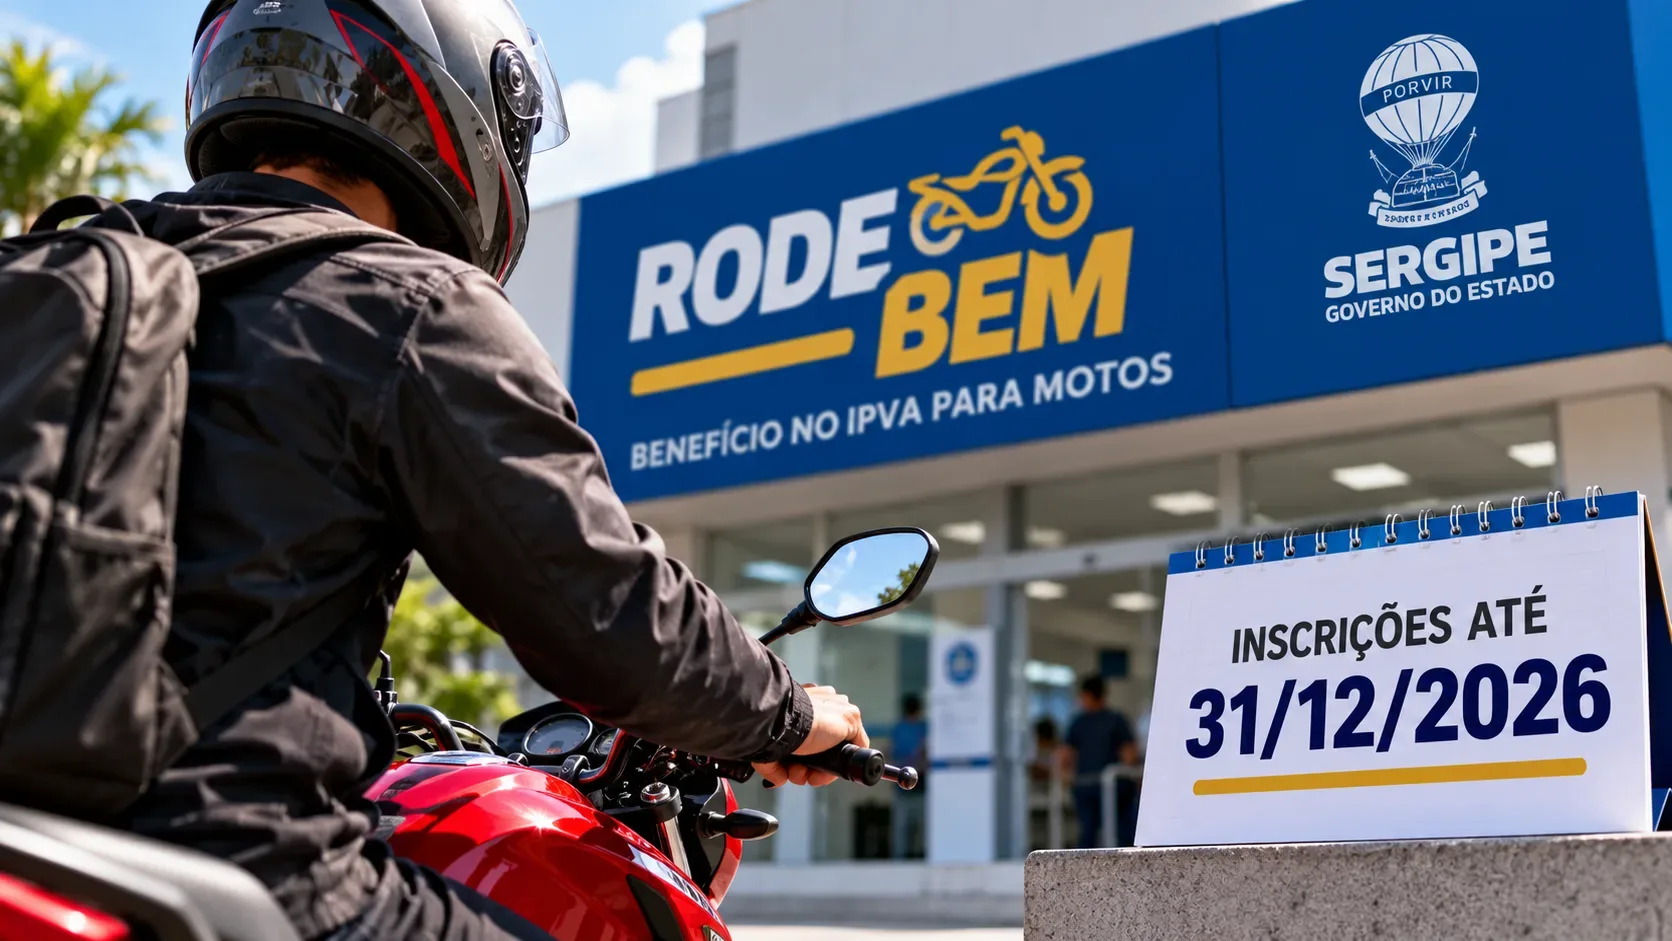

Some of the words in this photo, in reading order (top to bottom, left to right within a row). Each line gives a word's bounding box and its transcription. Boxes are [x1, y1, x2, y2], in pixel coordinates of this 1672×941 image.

[1382, 75, 1453, 103] PORVIR
[629, 188, 898, 342] RODE
[875, 227, 1134, 379] BEM
[1323, 220, 1552, 299] SERGIPE
[1325, 291, 1425, 323] GOVERNO
[1431, 285, 1462, 307] DO
[1468, 270, 1555, 301] ESTADO
[630, 420, 783, 471] BENEFÍCIO
[791, 411, 840, 445] NO
[846, 397, 922, 436] IPVA
[932, 379, 1023, 420] PARA
[1033, 352, 1173, 404] MOTOS
[1231, 601, 1452, 664] INSCRIÇÕES
[1467, 584, 1548, 641] ATÉ
[1185, 653, 1611, 761] 31/12/2026
